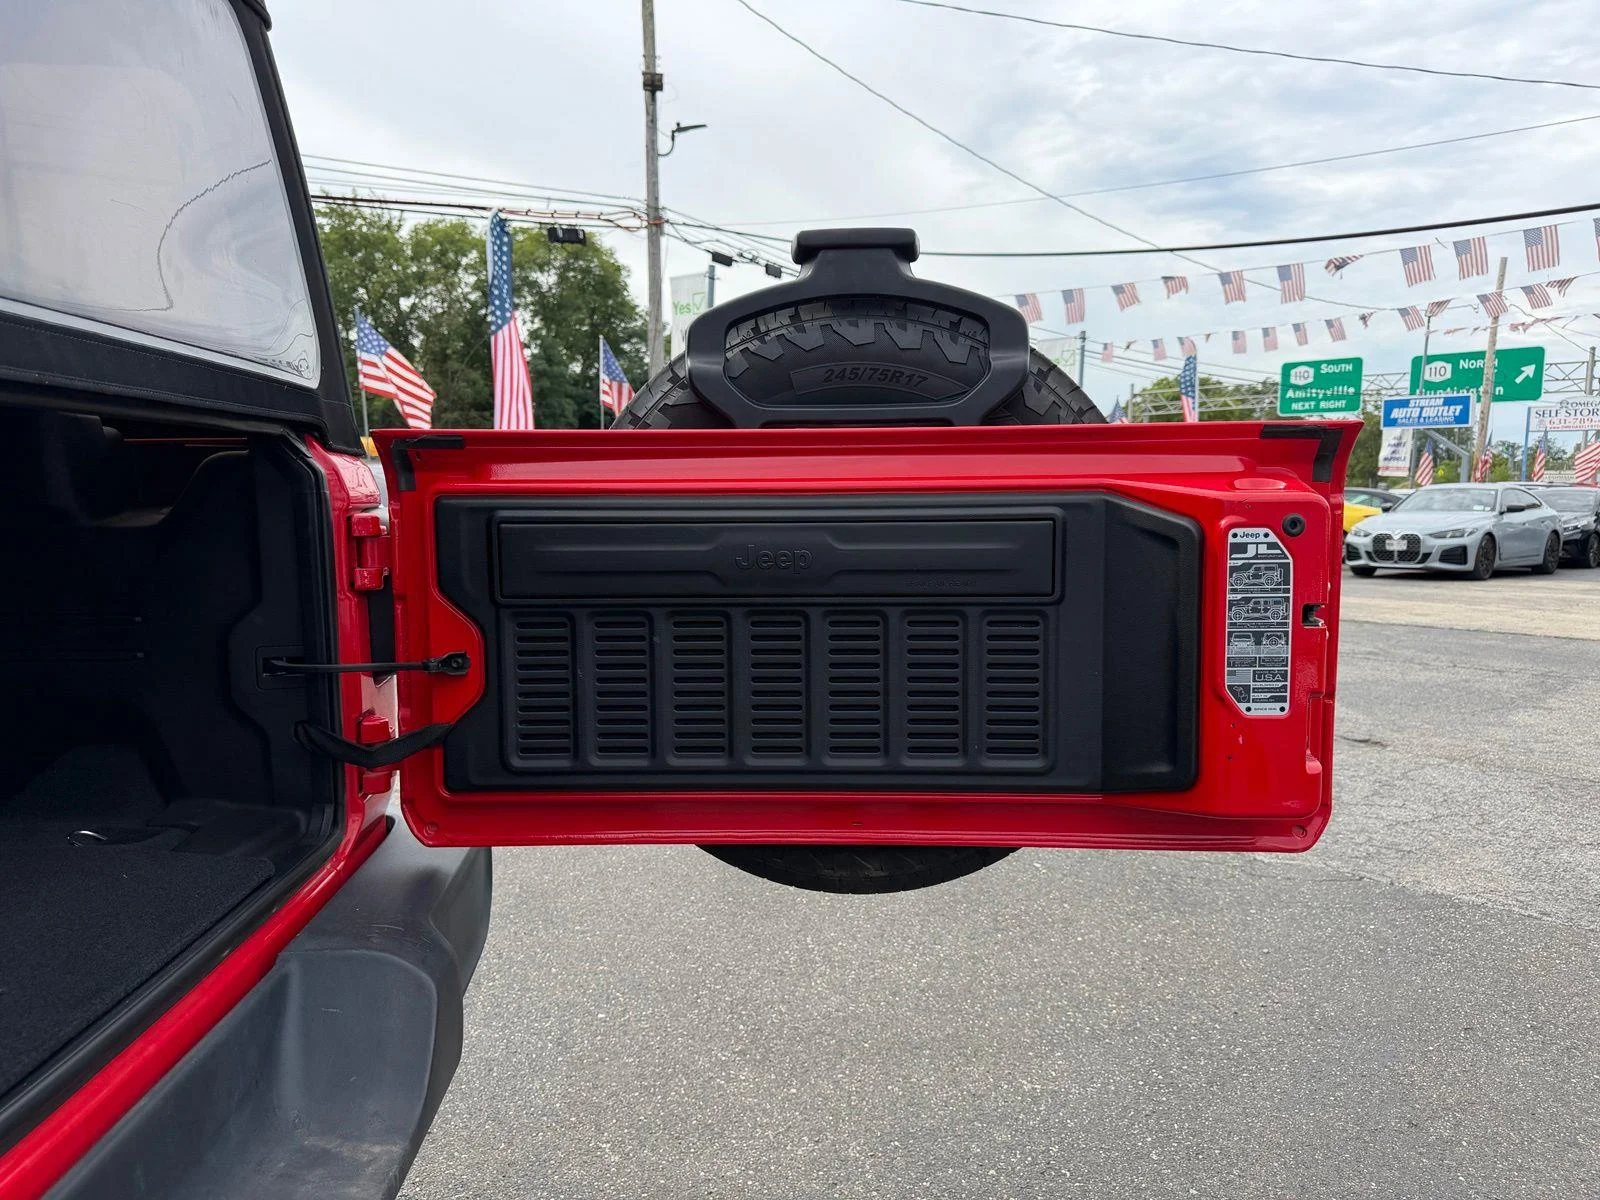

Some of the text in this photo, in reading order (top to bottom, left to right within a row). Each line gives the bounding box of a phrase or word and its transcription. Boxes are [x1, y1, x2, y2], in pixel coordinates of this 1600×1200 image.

[673, 301, 691, 315] Yes
[1294, 363, 1353, 381] 110 SOUTH
[1429, 359, 1498, 378] 110 NORH
[823, 366, 929, 388] 245/75R17
[1285, 384, 1355, 400] Amityville
[1291, 400, 1347, 411] NEXT RIGHT
[1409, 398, 1445, 408] STREAM
[1390, 405, 1463, 419] AUTO OUTLET
[1535, 409, 1561, 418] SELF
[1240, 531, 1260, 539] Jeep
[1231, 544, 1282, 558] JL
[735, 544, 813, 575] Jeep
[1255, 674, 1284, 682] U.S.A.
